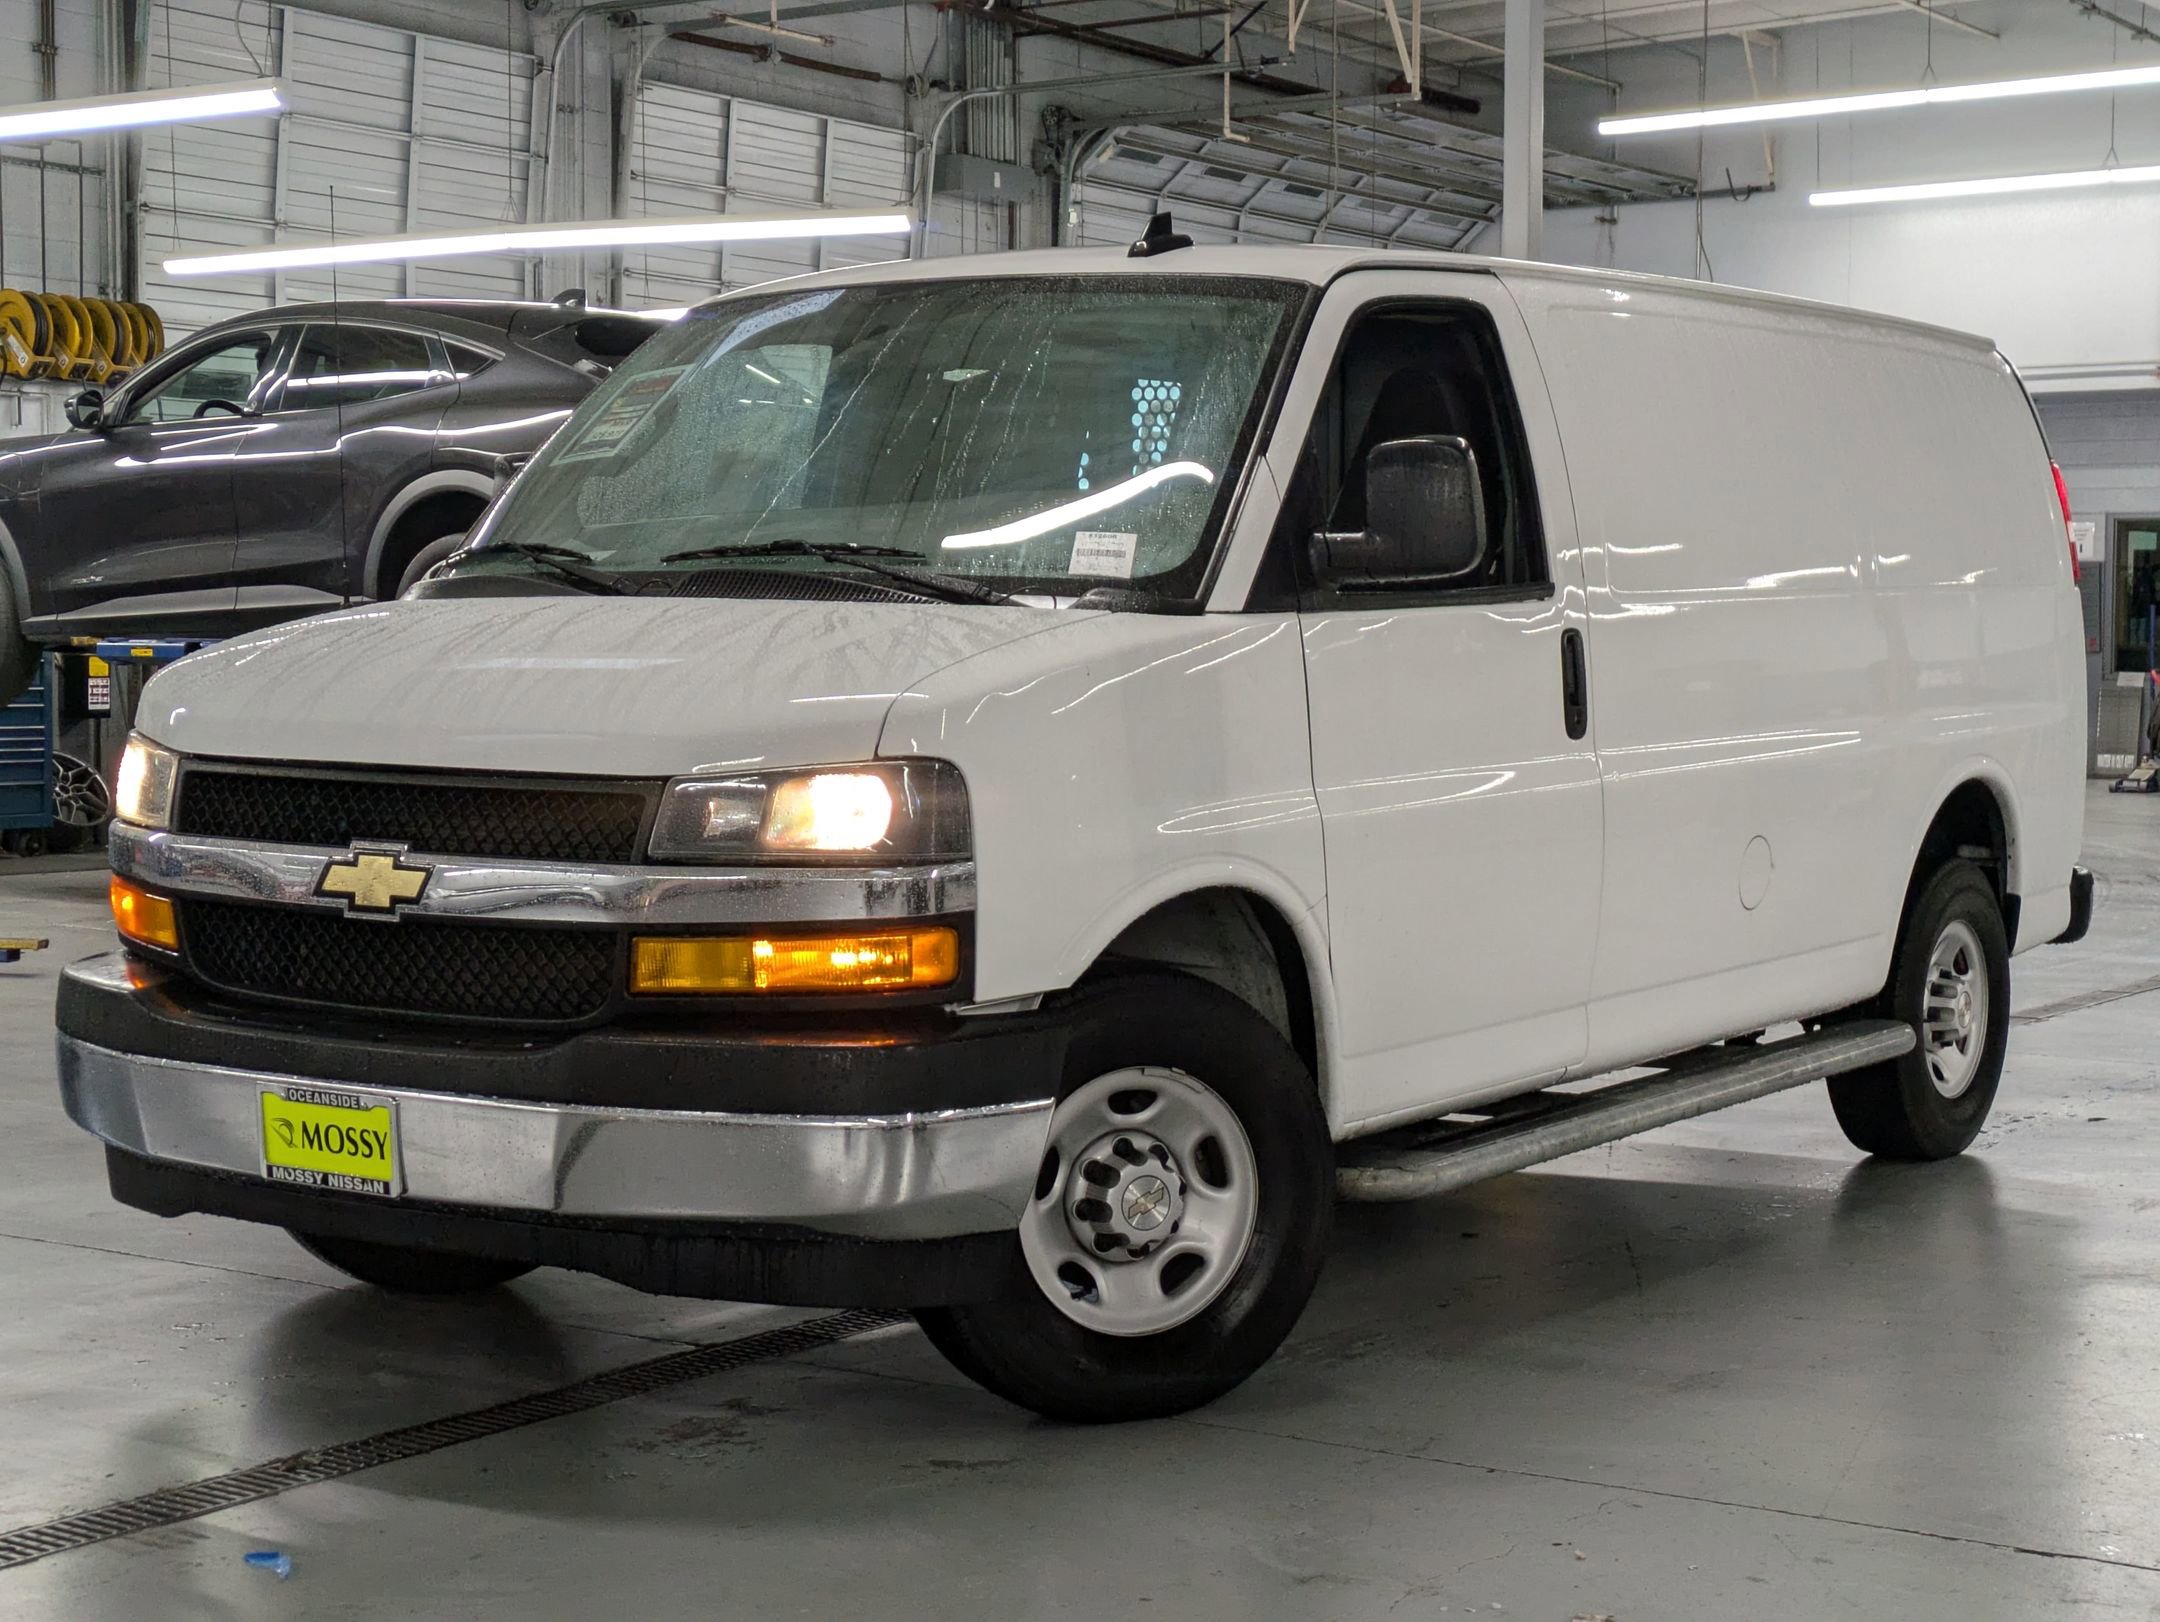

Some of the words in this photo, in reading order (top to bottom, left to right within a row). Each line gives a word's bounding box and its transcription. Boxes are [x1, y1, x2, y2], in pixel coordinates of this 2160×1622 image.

[289, 1089, 359, 1108] OCEANSIDE
[301, 1120, 388, 1160] MOSSY
[272, 1166, 323, 1185] MOSSY
[328, 1175, 384, 1193] NISSAN
